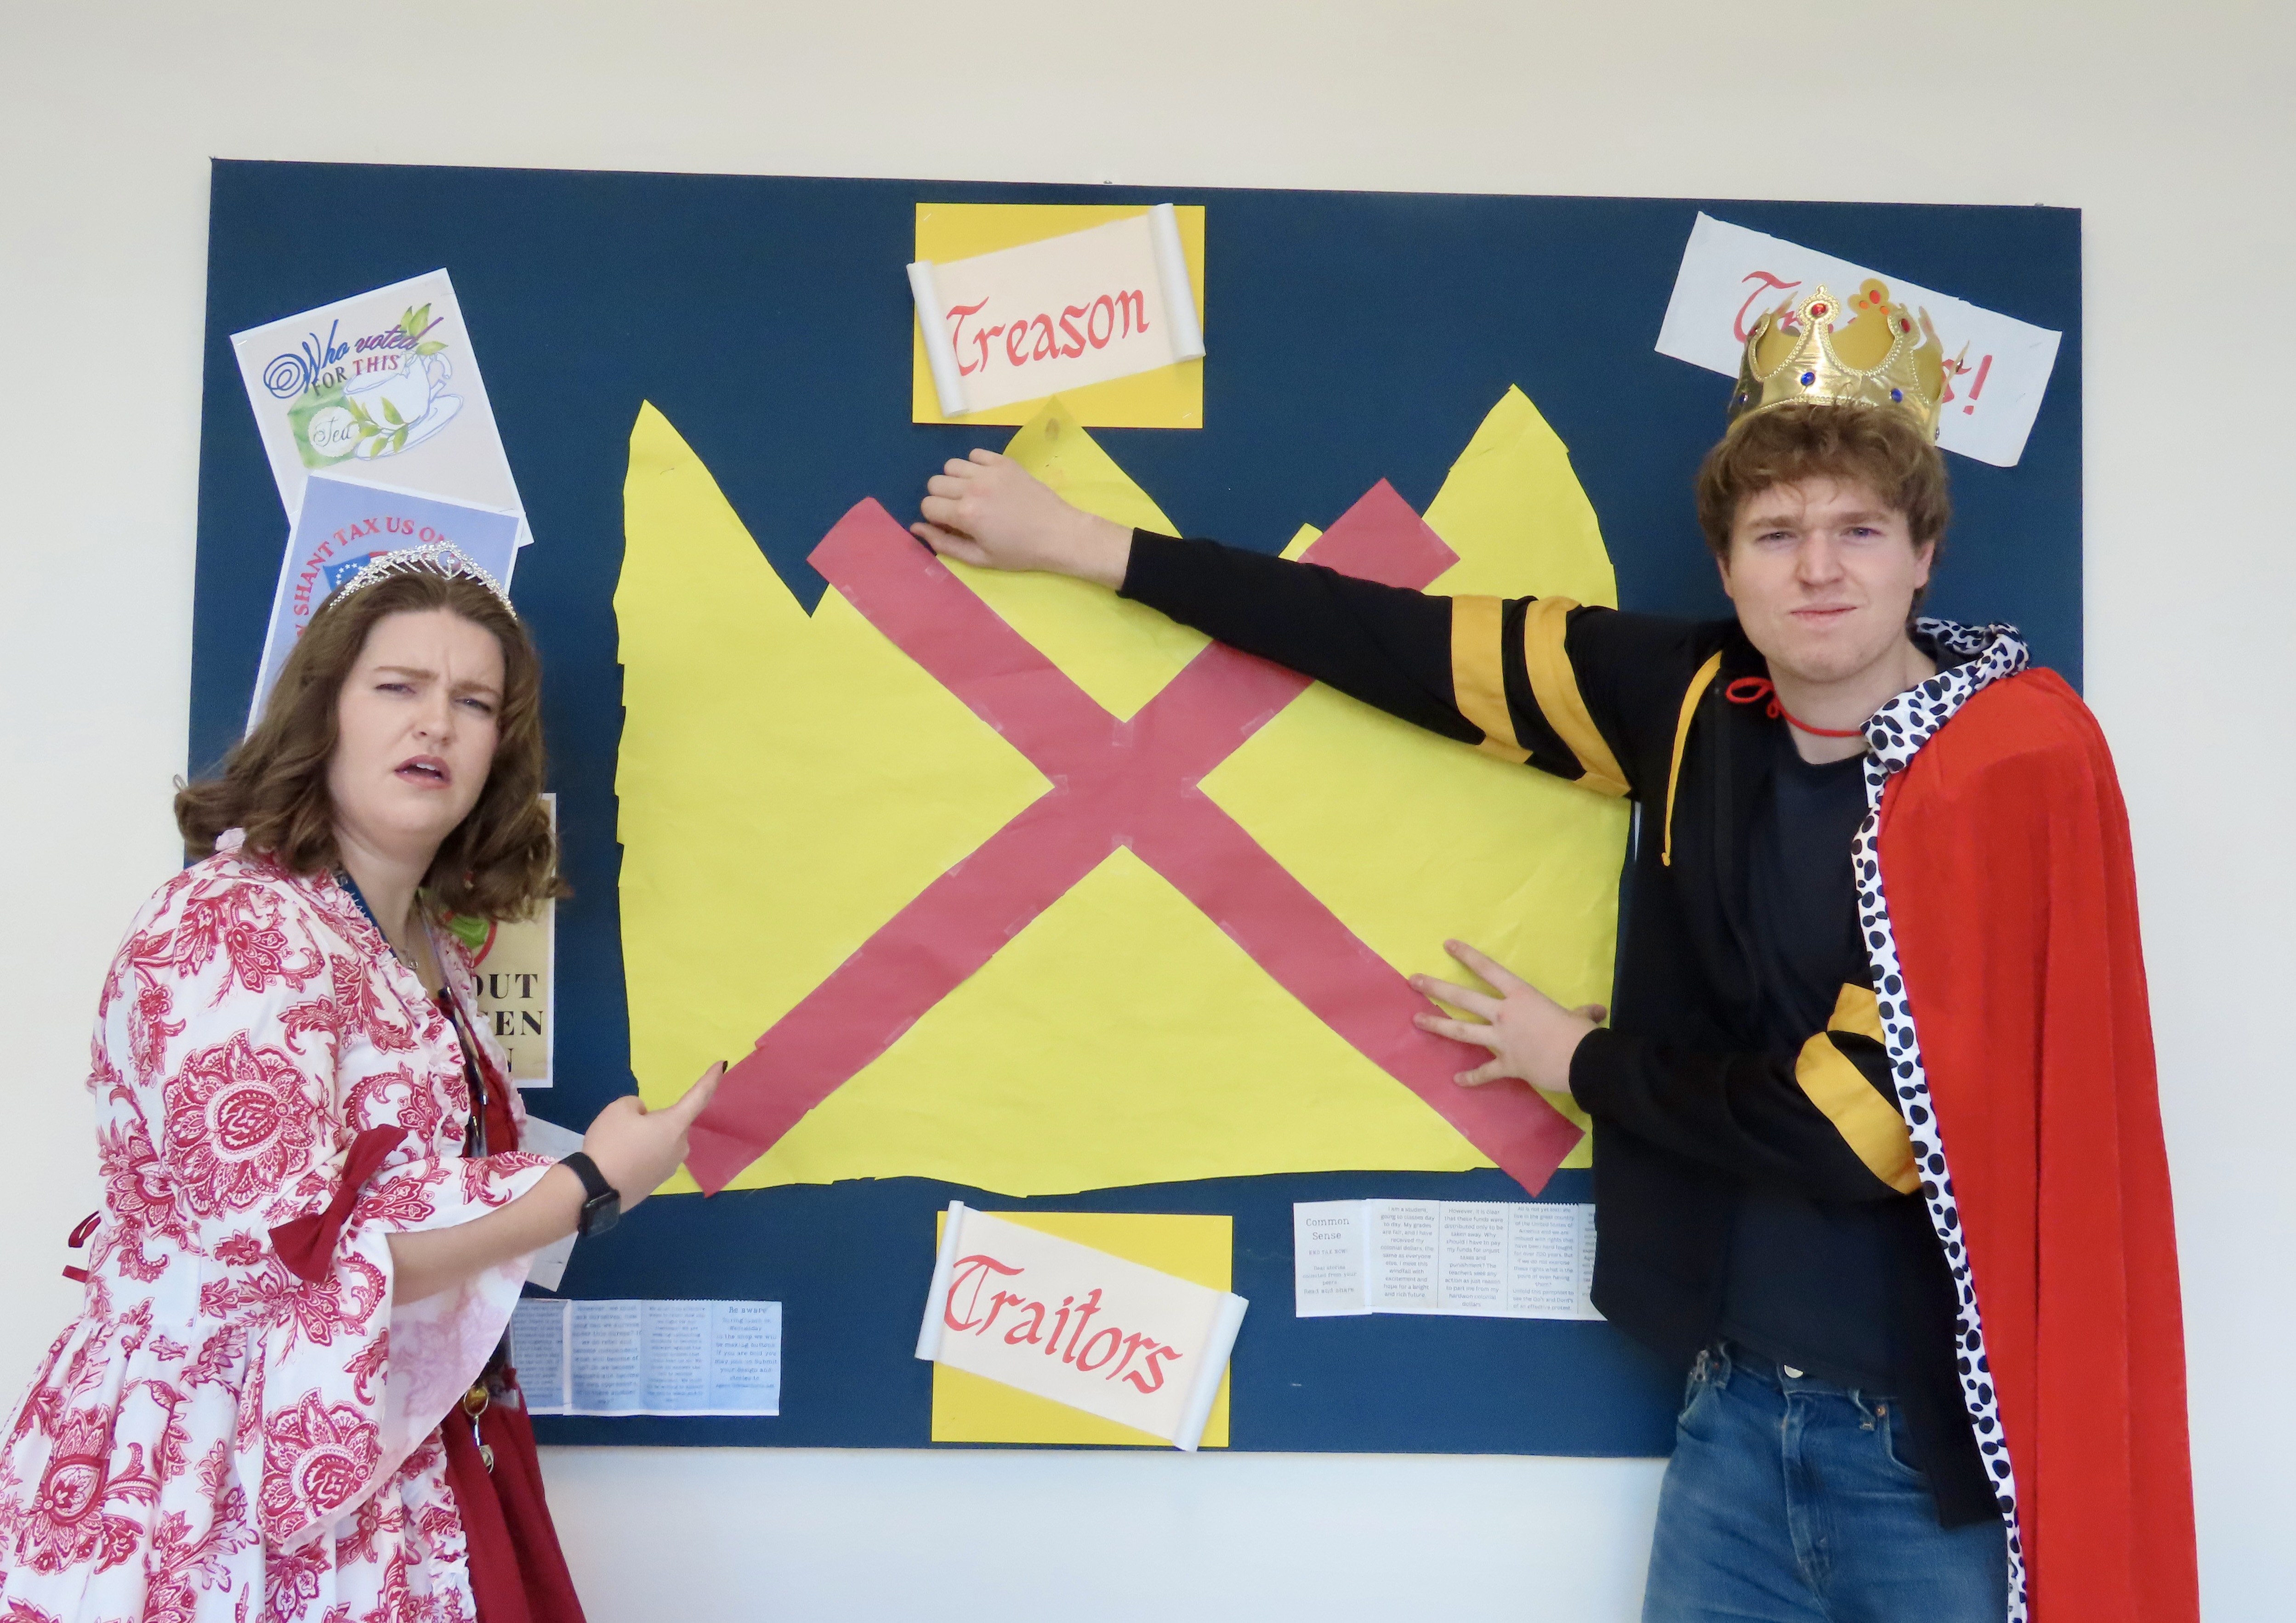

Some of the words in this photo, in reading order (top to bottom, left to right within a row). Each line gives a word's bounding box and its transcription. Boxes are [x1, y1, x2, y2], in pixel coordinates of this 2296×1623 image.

[263, 319, 350, 398] Who
[355, 317, 444, 350] voted
[946, 289, 1149, 376] Treason
[313, 367, 347, 396] FOR
[352, 355, 398, 376] THIS
[313, 417, 352, 447] Tea
[294, 541, 334, 615] SHANT
[334, 518, 380, 546] TAX
[386, 517, 414, 534] US
[1306, 1218, 1349, 1226] Common
[944, 1254, 1182, 1394] Traitors
